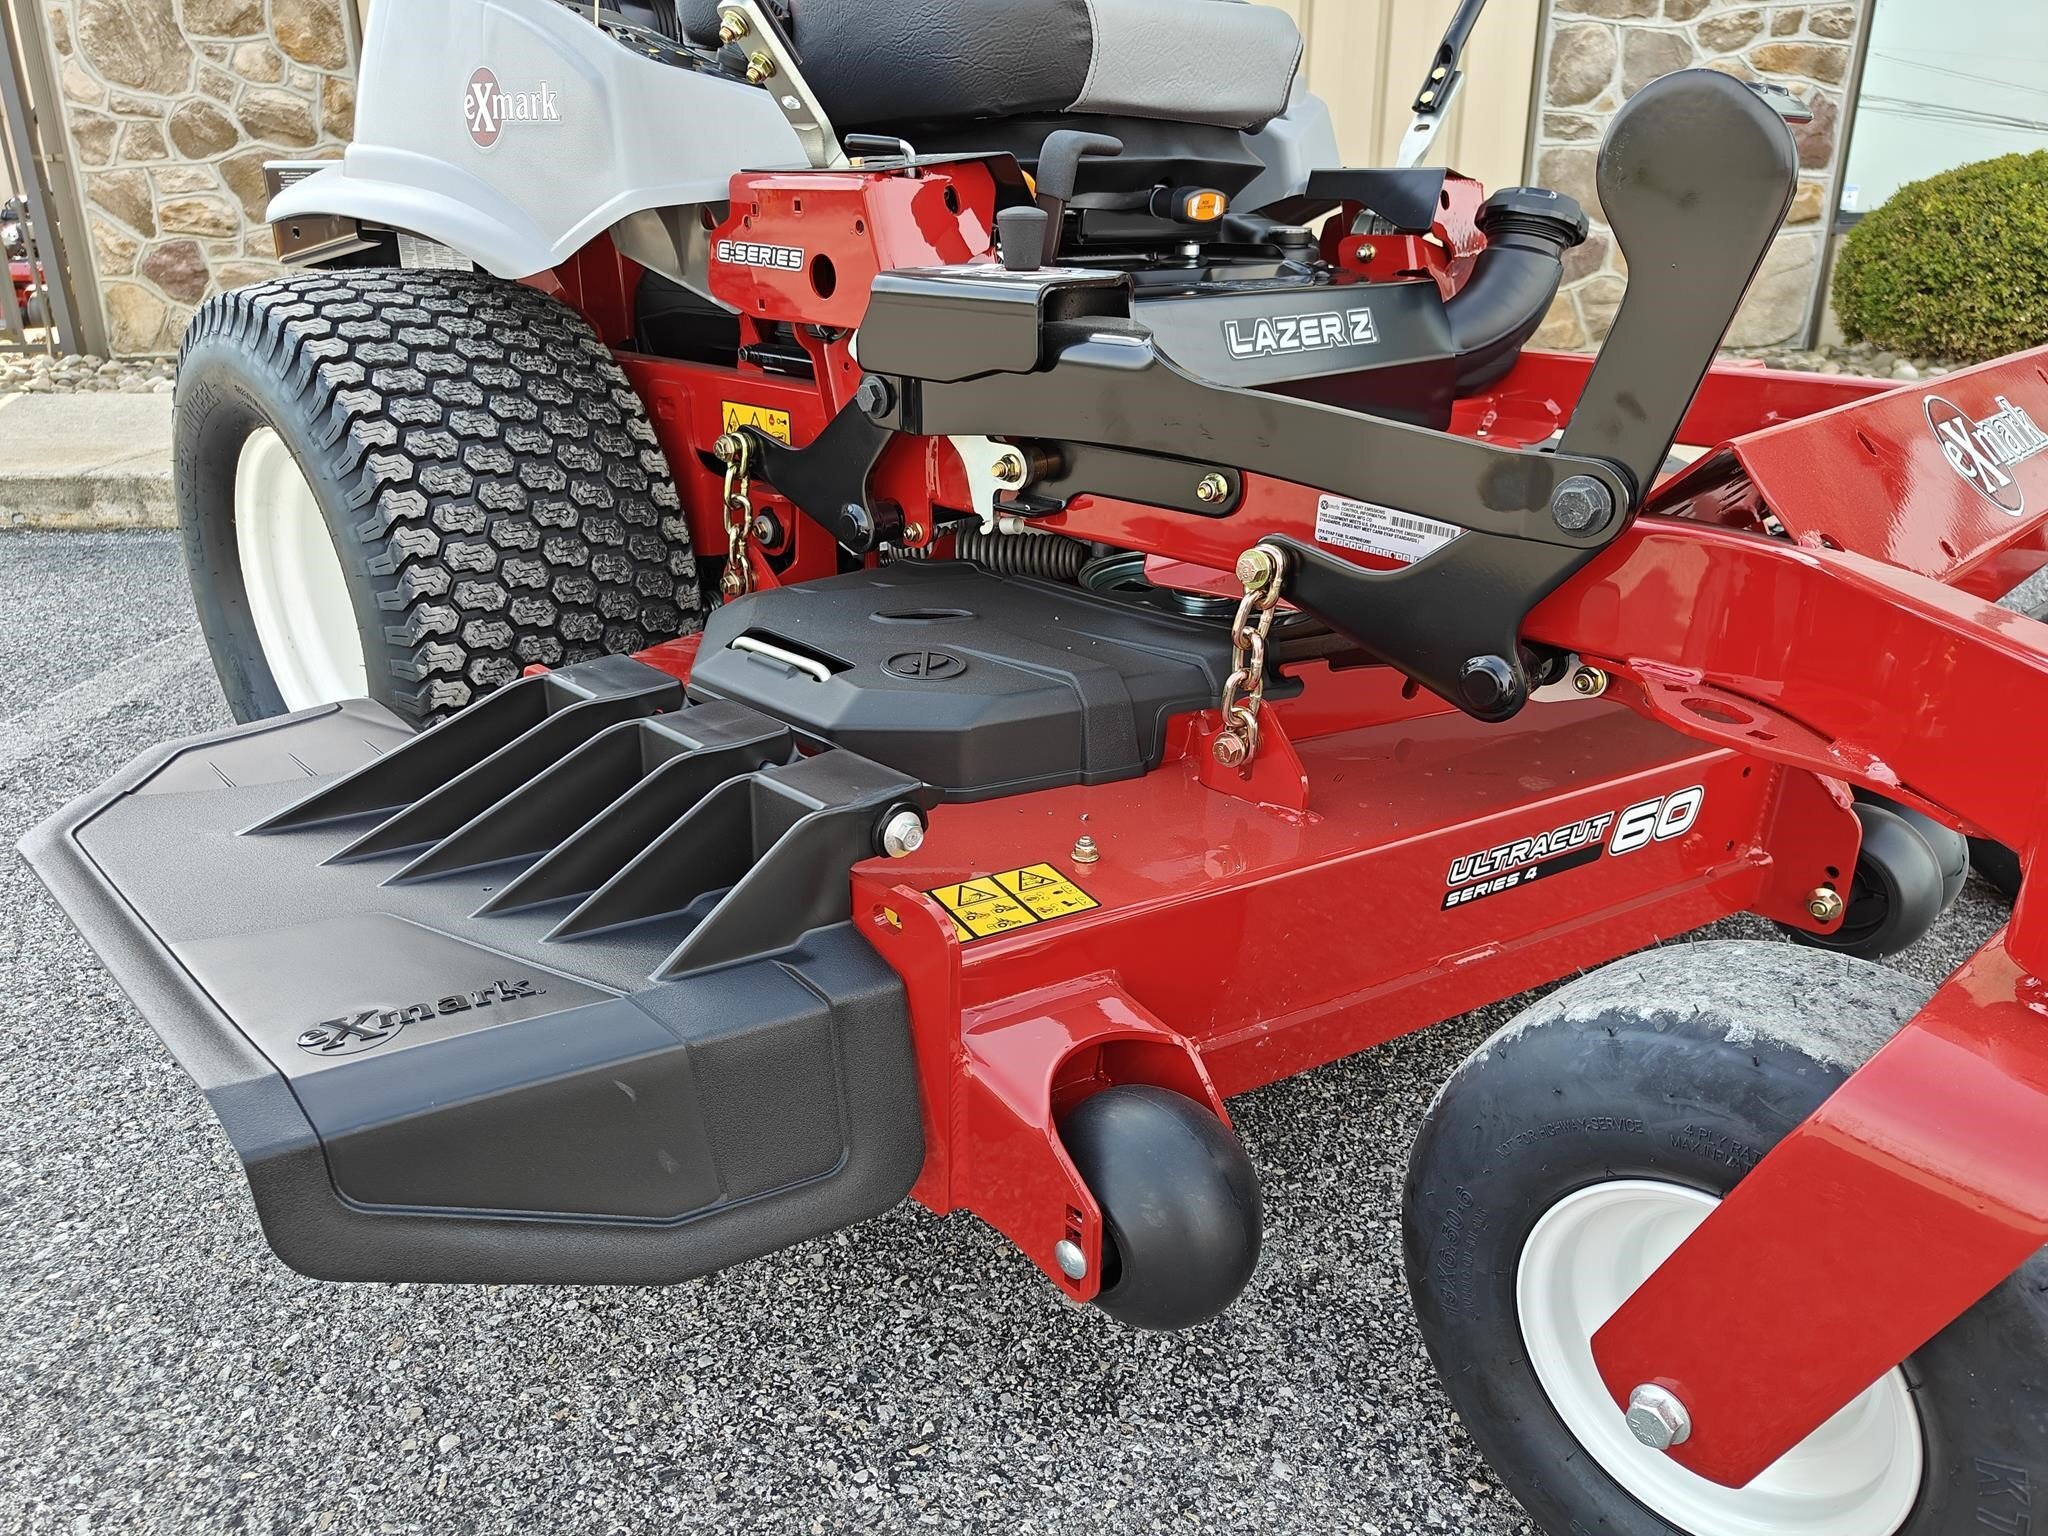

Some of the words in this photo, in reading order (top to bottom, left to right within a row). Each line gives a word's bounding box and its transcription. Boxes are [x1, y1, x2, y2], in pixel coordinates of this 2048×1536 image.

[463, 82, 558, 132] eXmark
[718, 241, 804, 271] E-SERIES
[1226, 315, 1348, 358] LAZER
[1347, 308, 1377, 345] Z
[1938, 397, 2048, 494] eXmark
[1448, 813, 1614, 885] ULTRACUT
[1609, 785, 1704, 857] 60
[1445, 874, 1519, 907] SERIES
[1525, 866, 1538, 880] 4
[297, 979, 537, 1051] eXmark
[1589, 1116, 1644, 1134] SERVICE
[1698, 1127, 1728, 1148] PLY
